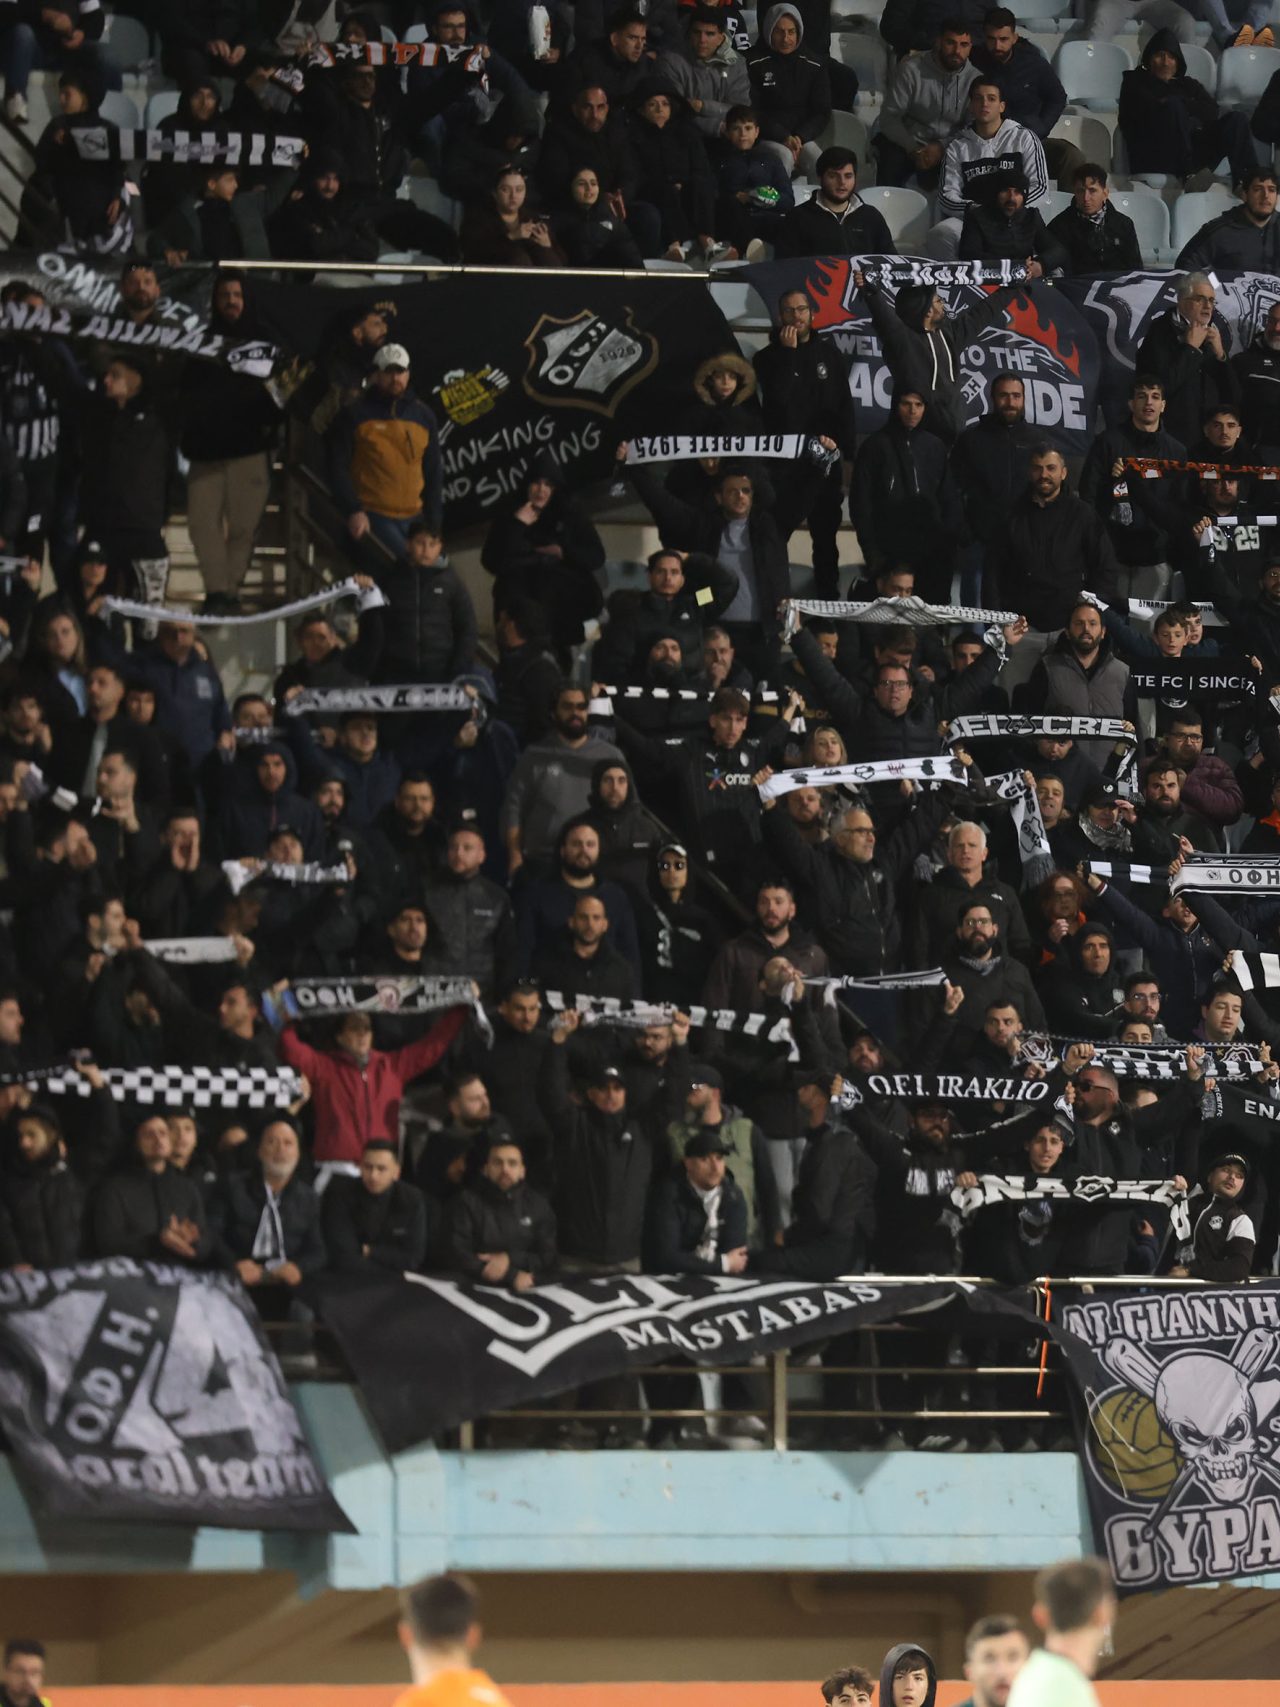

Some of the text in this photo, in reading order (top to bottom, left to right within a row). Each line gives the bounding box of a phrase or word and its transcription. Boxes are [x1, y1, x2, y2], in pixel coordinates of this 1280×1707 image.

[988, 343, 1037, 372] THE
[1024, 377, 1088, 432] IDE
[635, 436, 681, 459] 1925
[689, 435, 746, 454] CRETE
[476, 421, 602, 507] SINING
[1161, 676, 1183, 688] FC
[1042, 717, 1126, 737] CRE
[867, 1075, 1049, 1101] O.F.I. IRAKLIO
[612, 1283, 884, 1352] MASTABAS
